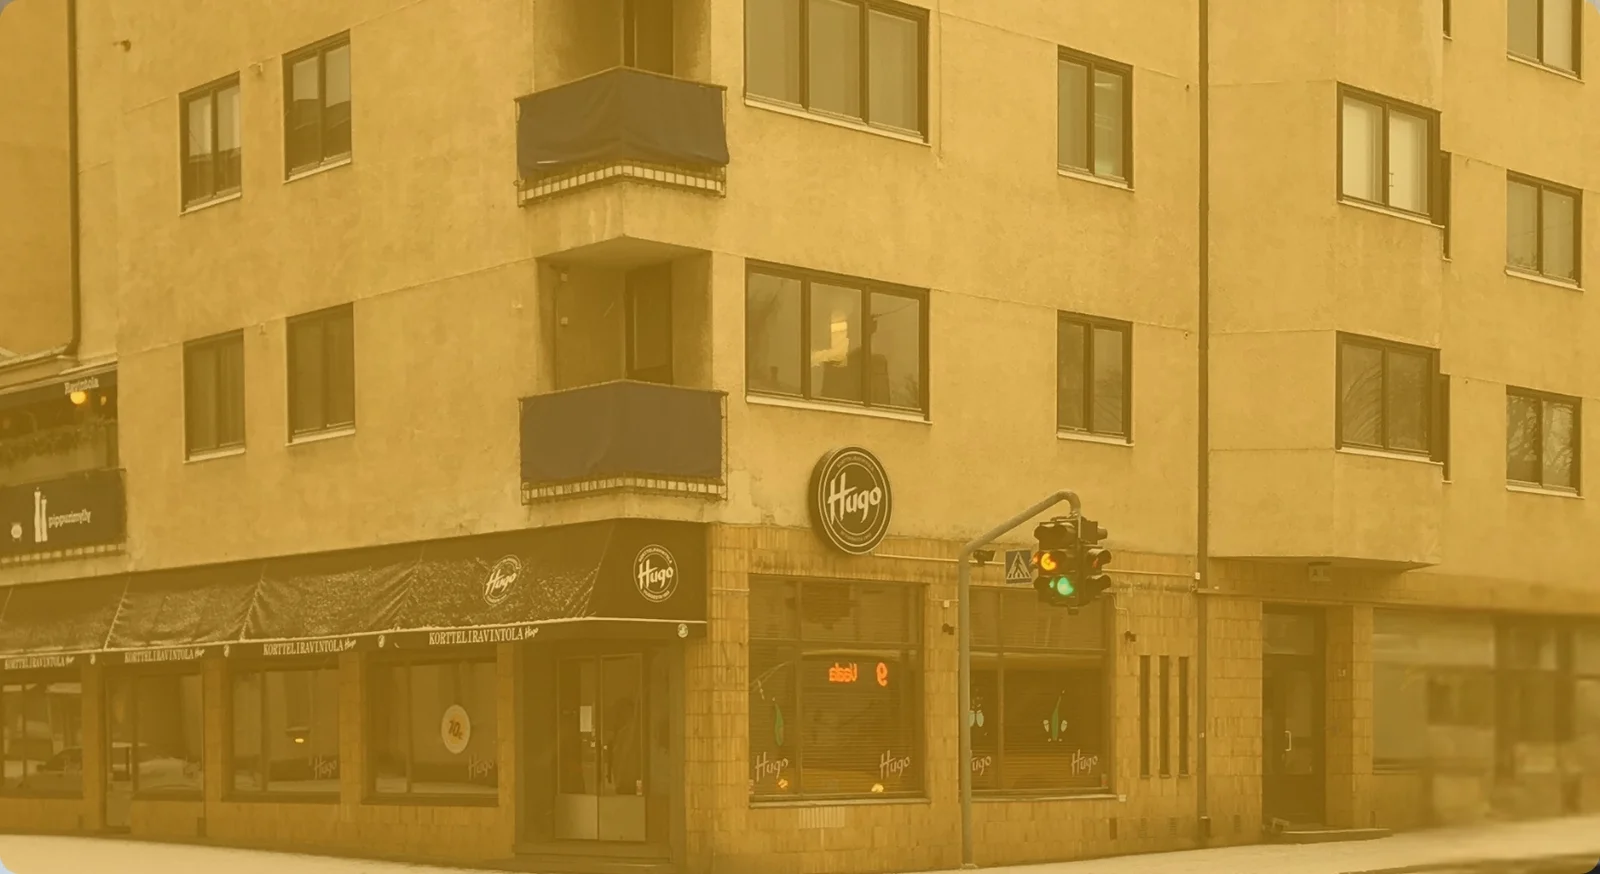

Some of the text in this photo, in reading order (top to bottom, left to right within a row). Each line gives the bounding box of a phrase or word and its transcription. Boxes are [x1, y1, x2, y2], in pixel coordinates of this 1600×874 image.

[826, 471, 882, 525] Hugo
[484, 568, 517, 596] Hugo
[637, 558, 675, 590] Hugo
[262, 638, 344, 657] KORTTELIRAVINTOLA
[428, 626, 524, 646] KORTTELIRAVINTOLA
[313, 753, 338, 780] Hugo
[467, 752, 497, 781] Hugo
[754, 751, 789, 783] Hugo
[878, 749, 911, 780] Hugo
[970, 750, 992, 777] ugo
[1070, 748, 1099, 777] Hugo
